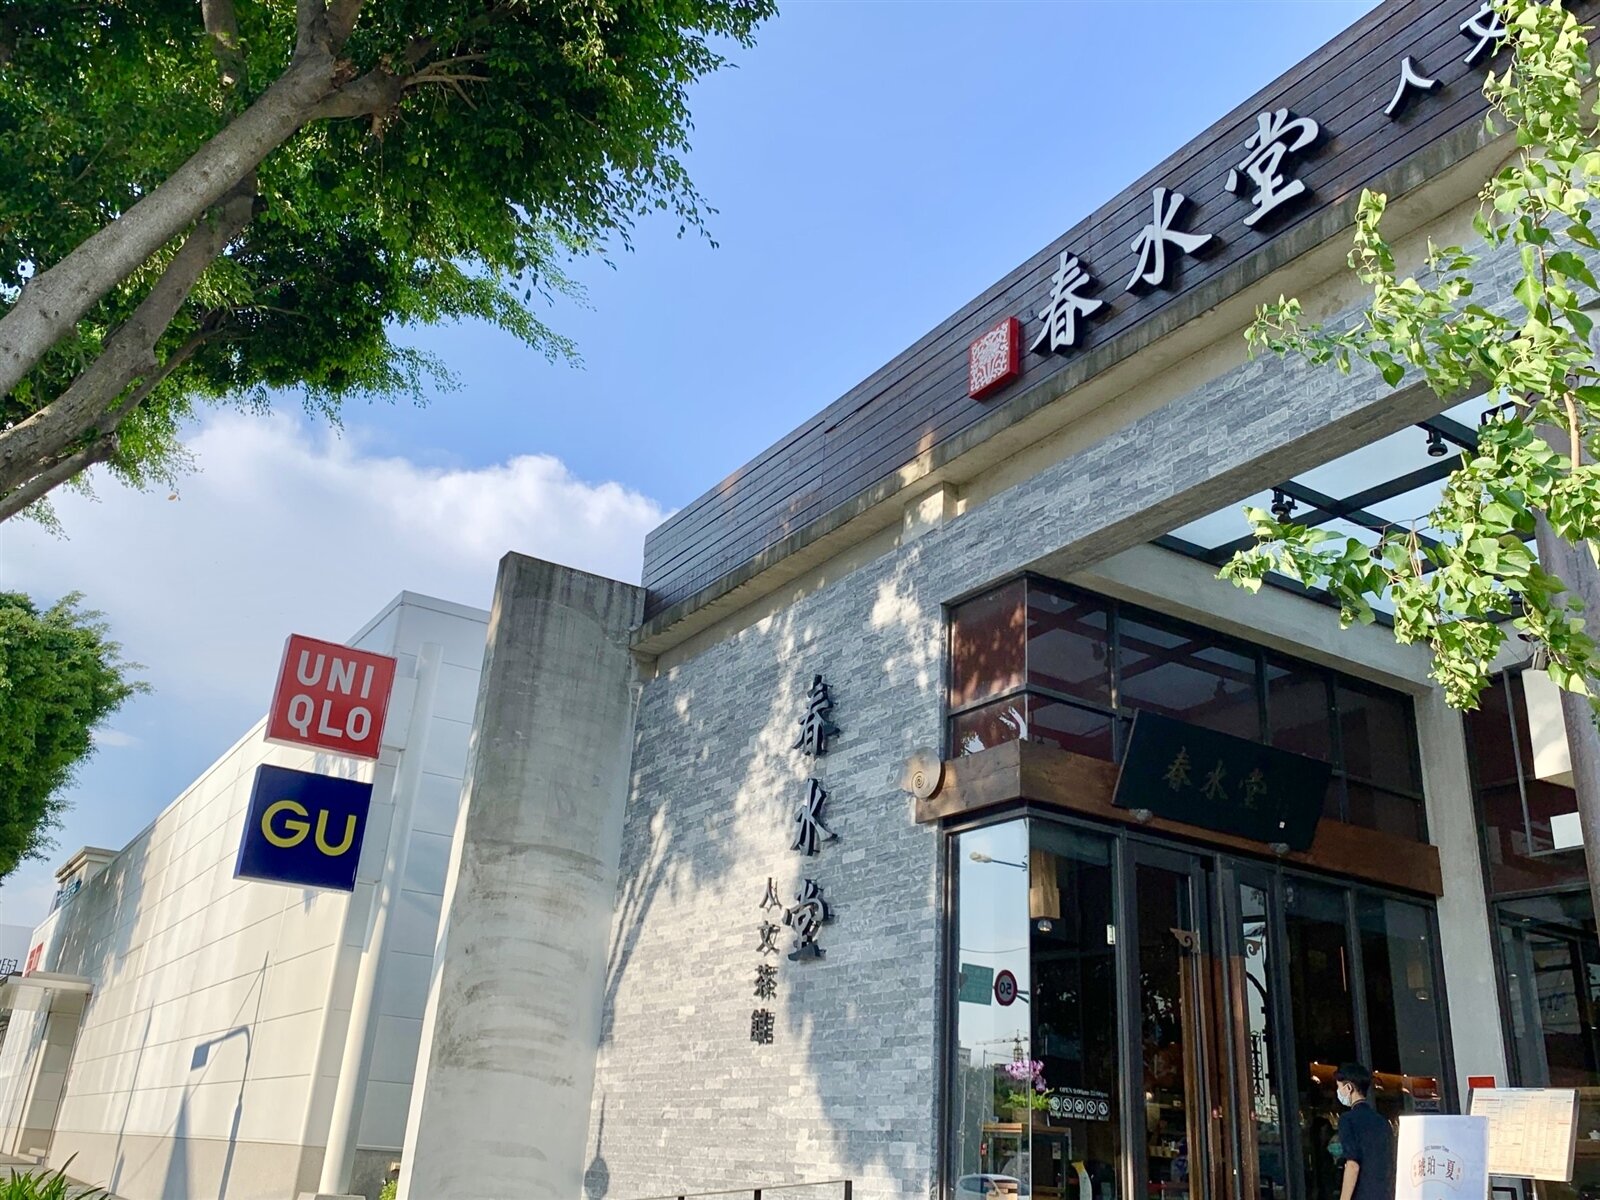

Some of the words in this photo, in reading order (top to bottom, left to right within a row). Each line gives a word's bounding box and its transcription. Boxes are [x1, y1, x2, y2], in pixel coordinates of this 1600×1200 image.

[1029, 107, 1320, 354] 春水堂
[295, 649, 375, 699] UNI
[286, 693, 373, 742] QLO
[260, 800, 358, 857] GU
[781, 673, 841, 962] 春水堂
